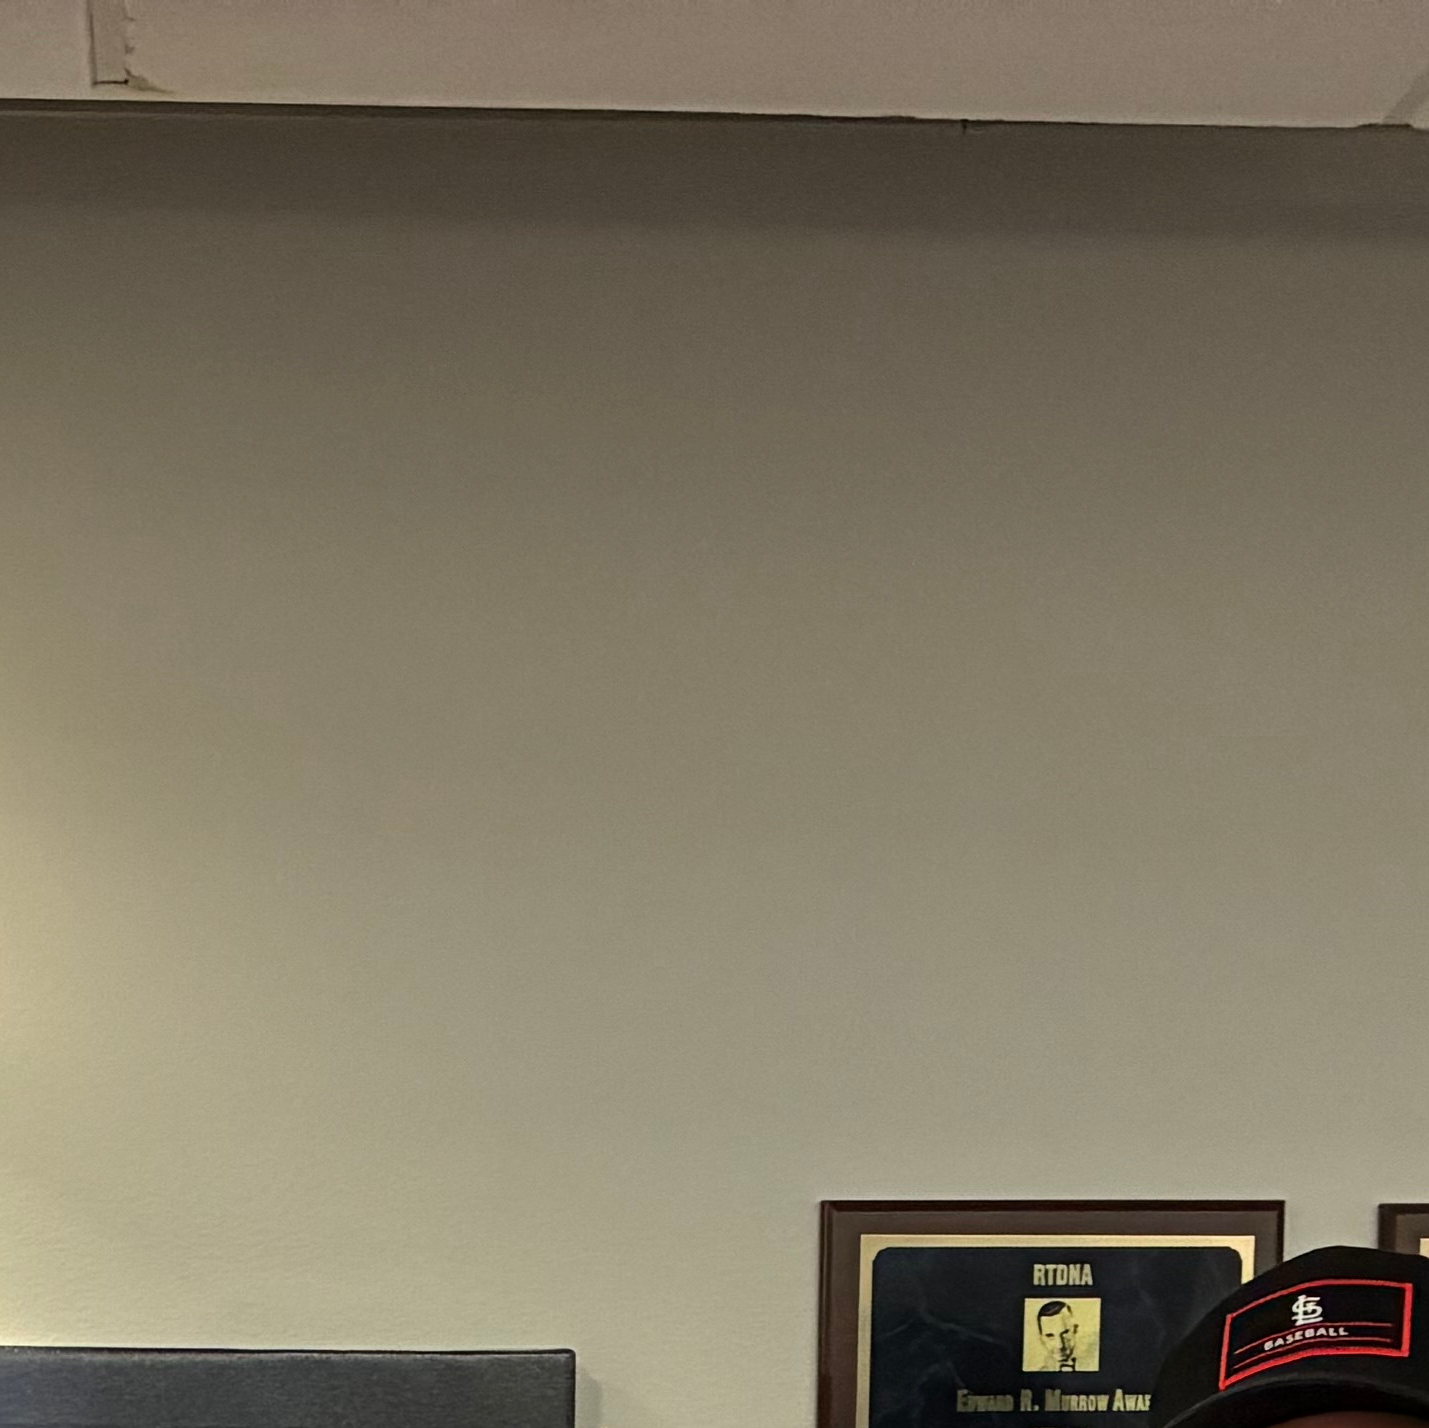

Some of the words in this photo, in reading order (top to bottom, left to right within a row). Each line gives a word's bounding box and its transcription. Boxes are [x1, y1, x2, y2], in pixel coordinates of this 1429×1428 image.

[1033, 1264, 1093, 1286] RTDNA
[1264, 1327, 1349, 1350] BASEBALL
[1020, 1390, 1039, 1411] R.
[1045, 1390, 1109, 1411] MURROW
